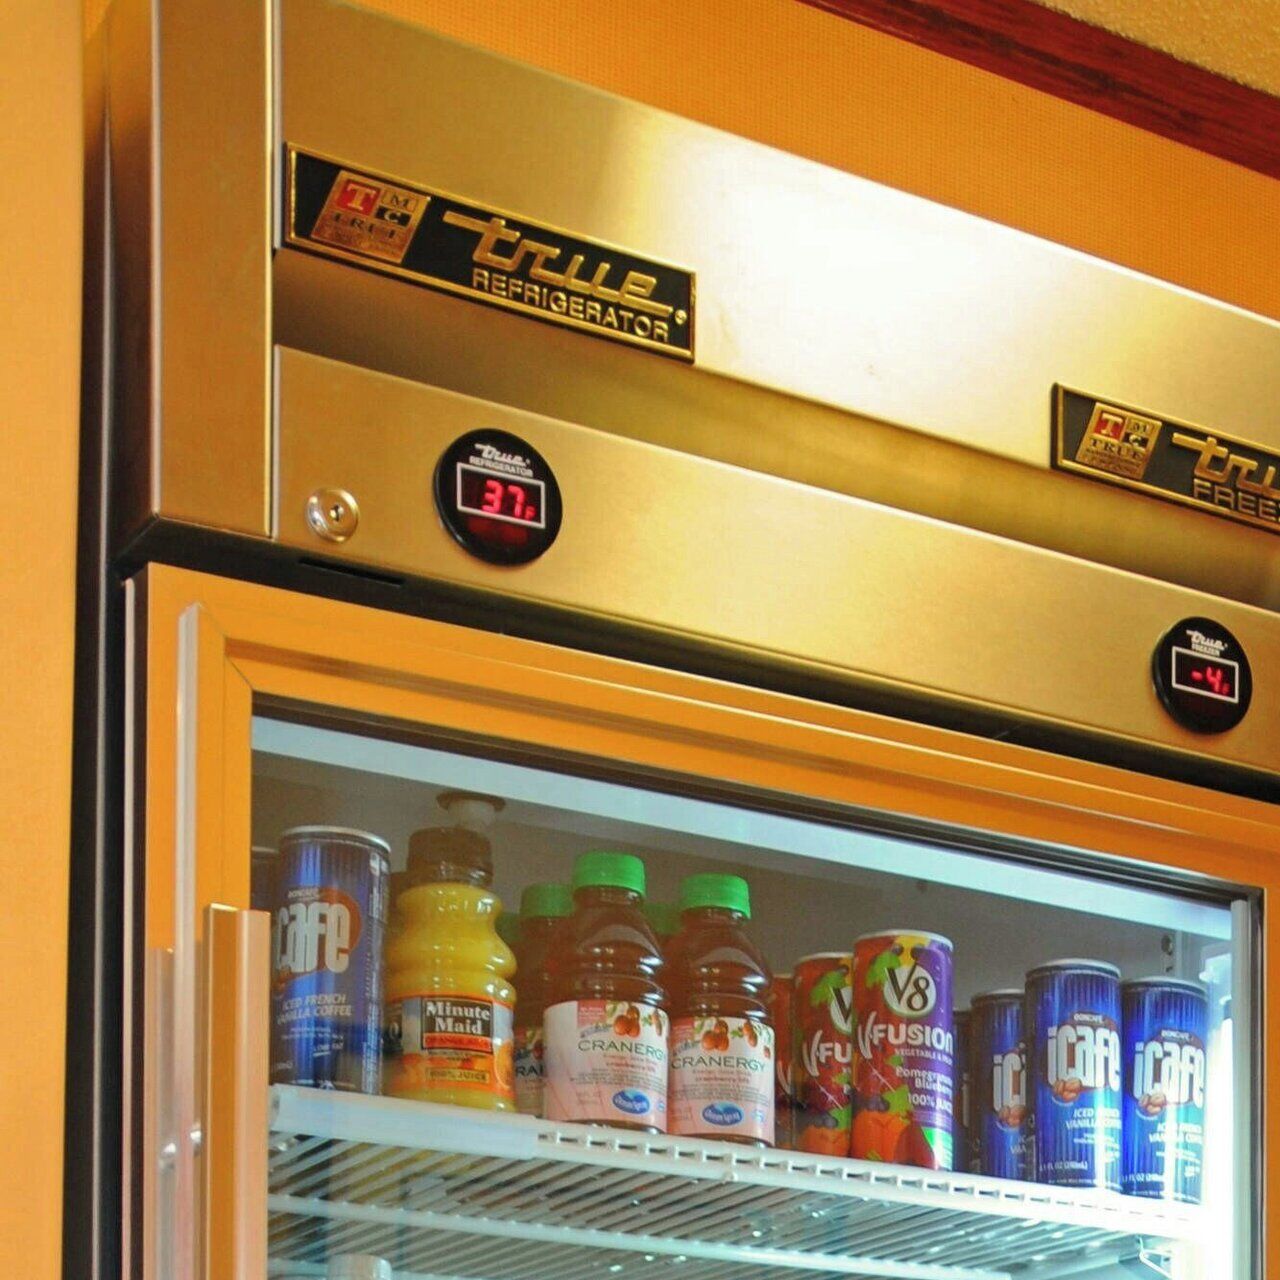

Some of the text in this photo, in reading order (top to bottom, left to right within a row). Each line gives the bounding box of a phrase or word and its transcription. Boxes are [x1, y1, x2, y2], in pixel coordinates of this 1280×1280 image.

[471, 266, 670, 344] REFRIGERATOR
[469, 456, 534, 478] REFRIGERATOR
[886, 961, 931, 1013] V8
[425, 1000, 492, 1022] Minute
[434, 1016, 484, 1036] Maid
[670, 1056, 765, 1073] CRANERGY
